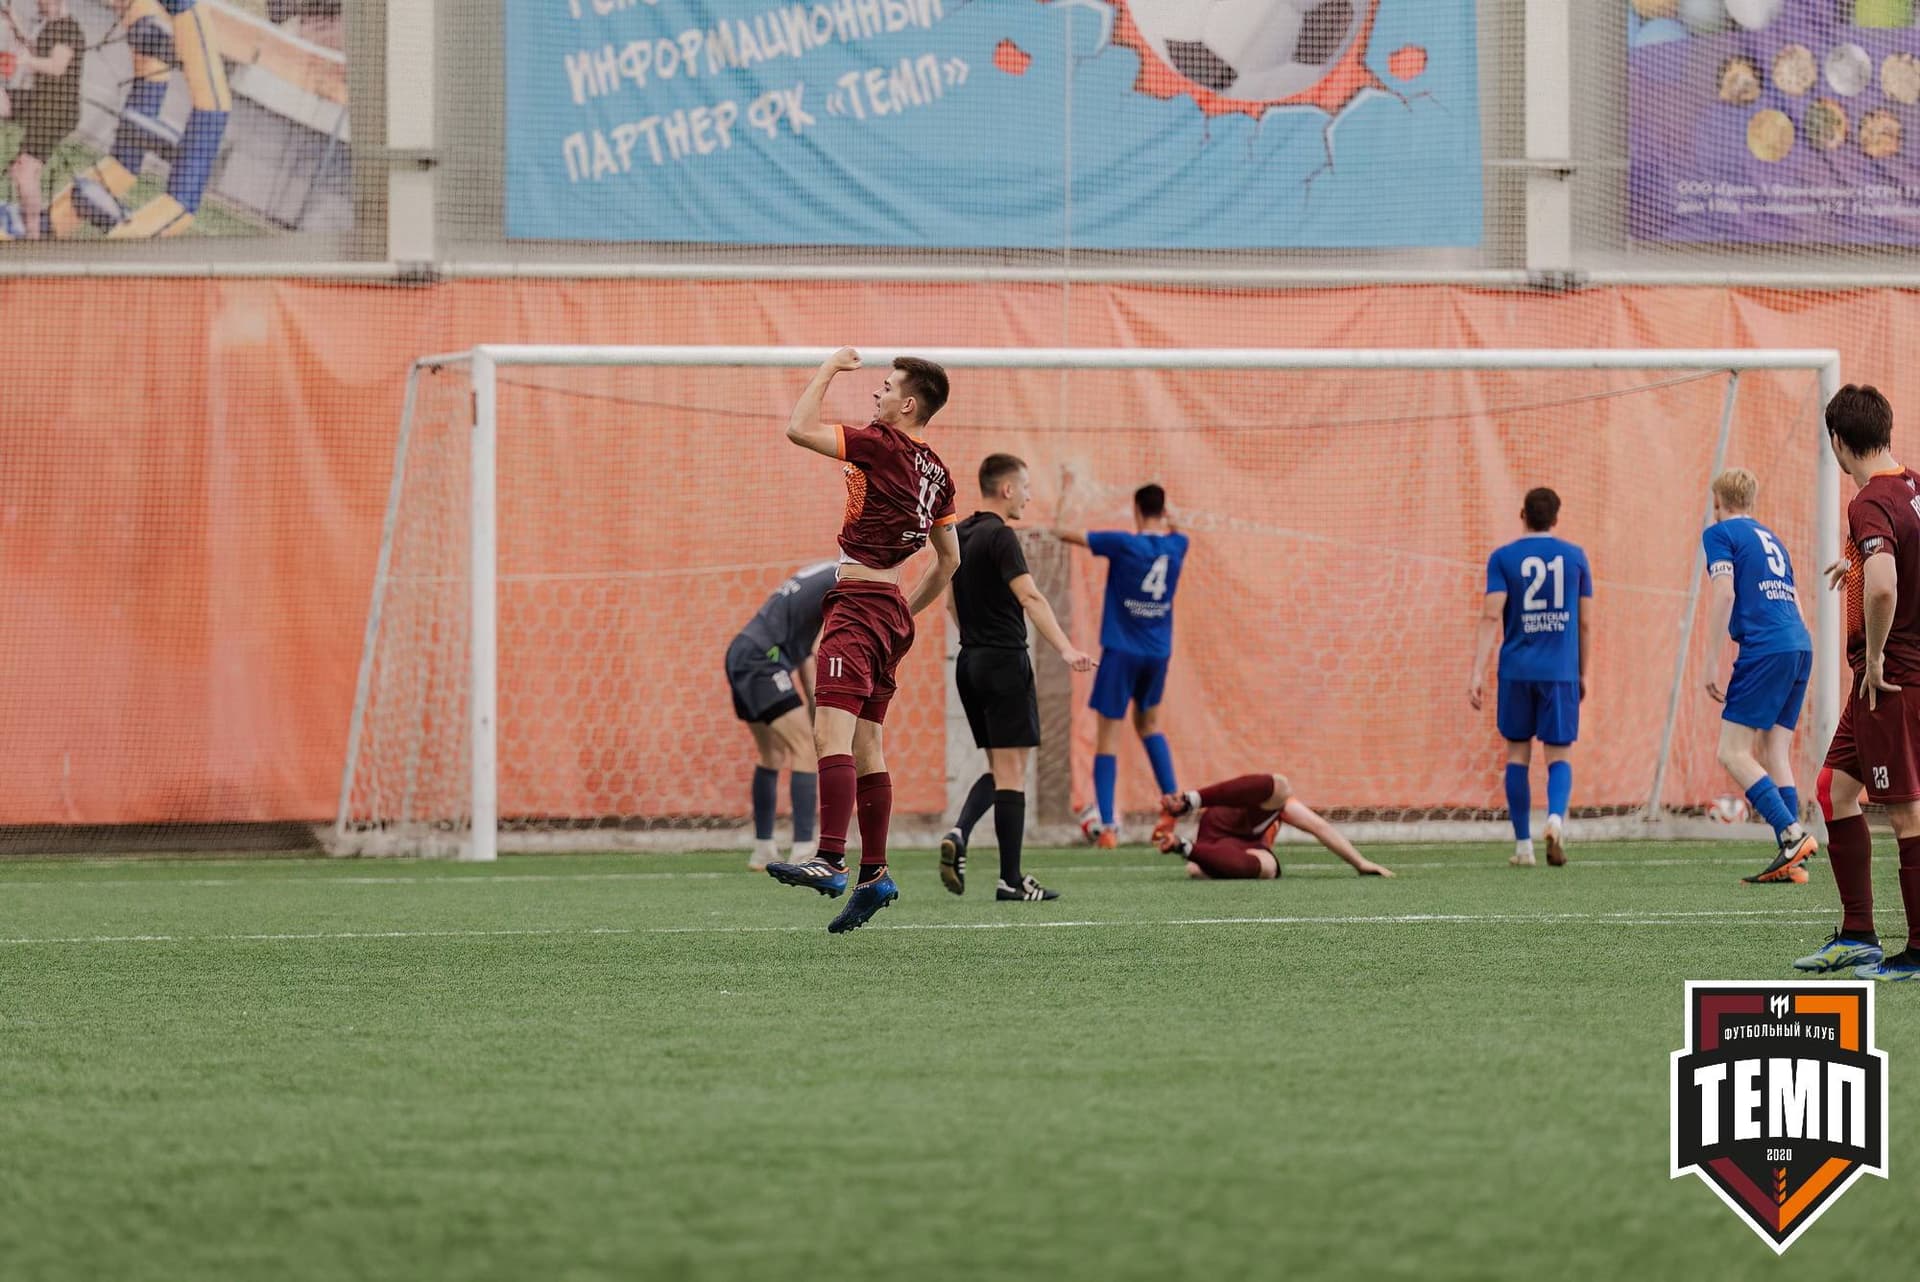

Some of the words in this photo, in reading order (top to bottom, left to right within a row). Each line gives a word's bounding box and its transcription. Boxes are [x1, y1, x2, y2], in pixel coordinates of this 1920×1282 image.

[563, 102, 738, 183] ПАРТНЕР
[748, 82, 816, 139] ФК
[827, 53, 970, 120] «ТЕМП»
[1141, 554, 1169, 600] 4
[1753, 528, 1786, 578] 5
[1521, 554, 1564, 611] 21
[829, 657, 843, 677] 11
[1873, 766, 1889, 789] 23
